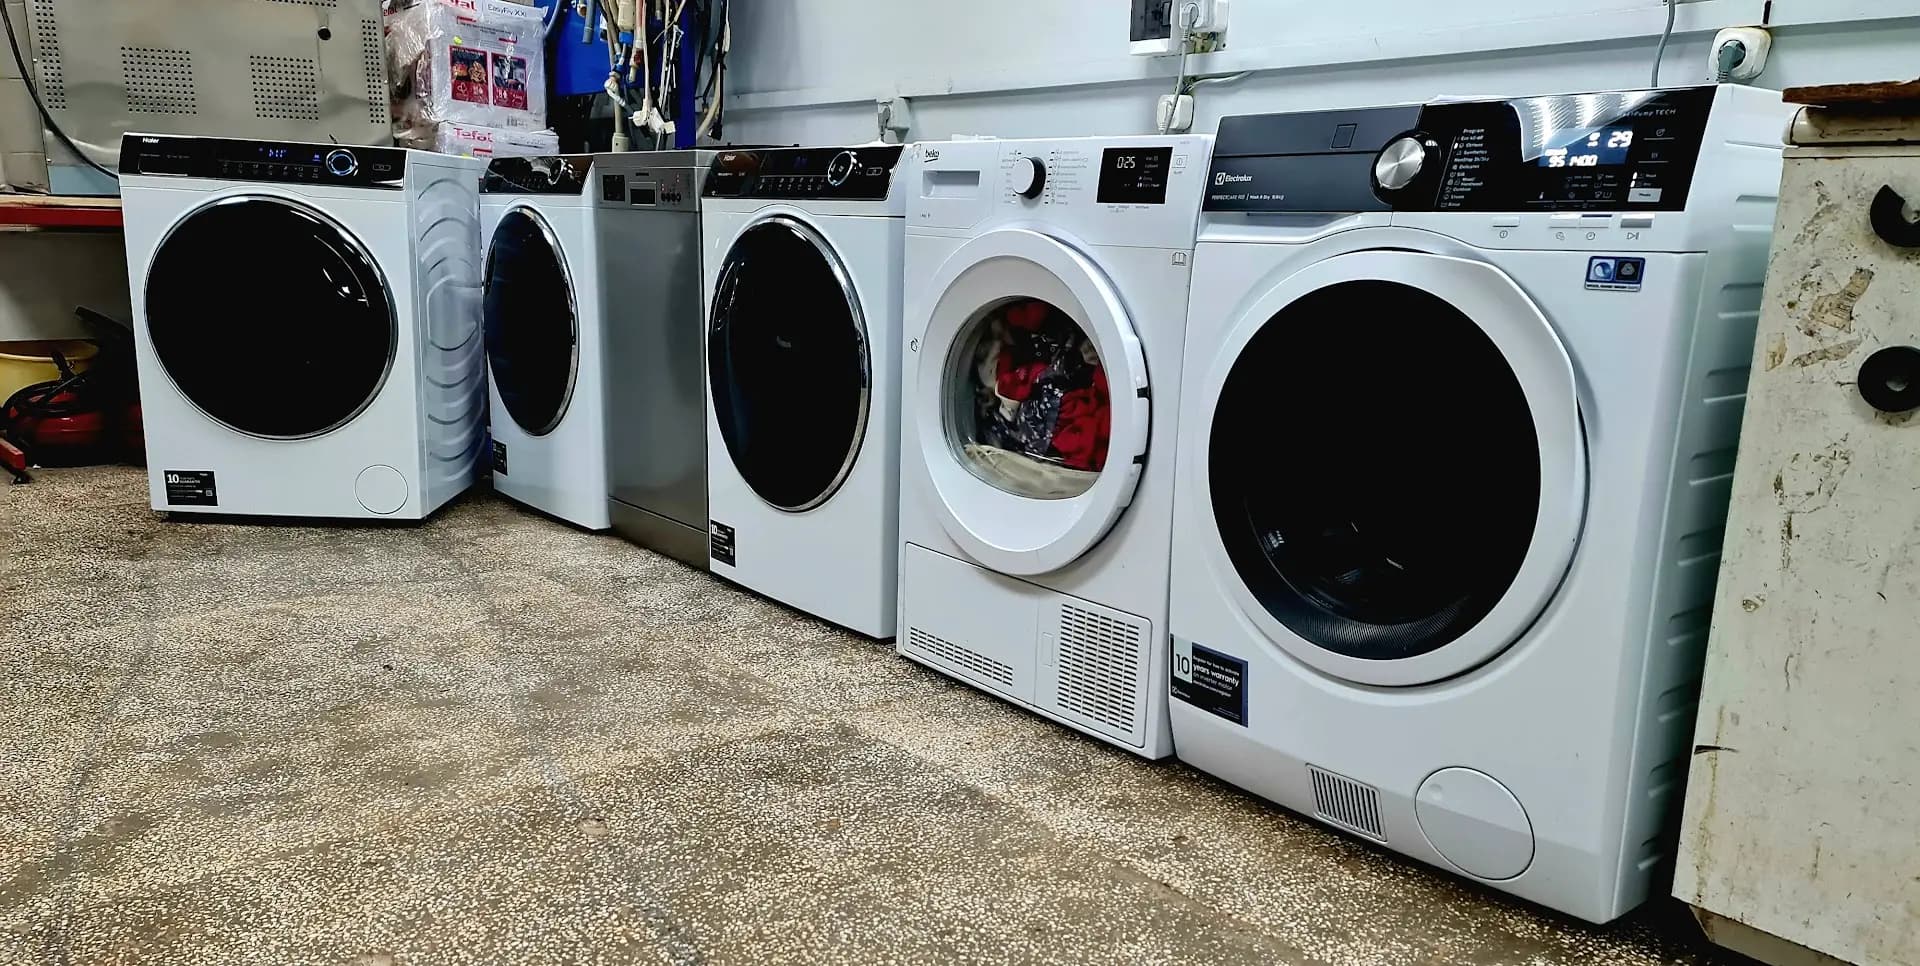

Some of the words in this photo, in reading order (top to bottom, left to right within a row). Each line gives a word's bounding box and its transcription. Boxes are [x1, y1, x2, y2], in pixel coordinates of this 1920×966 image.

[453, 128, 493, 142] Tefal
[1225, 174, 1252, 183] Electrolux
[167, 473, 179, 483] 10
[1176, 653, 1190, 675] 10
[1193, 664, 1210, 675] years
[1211, 670, 1239, 687] warranty
